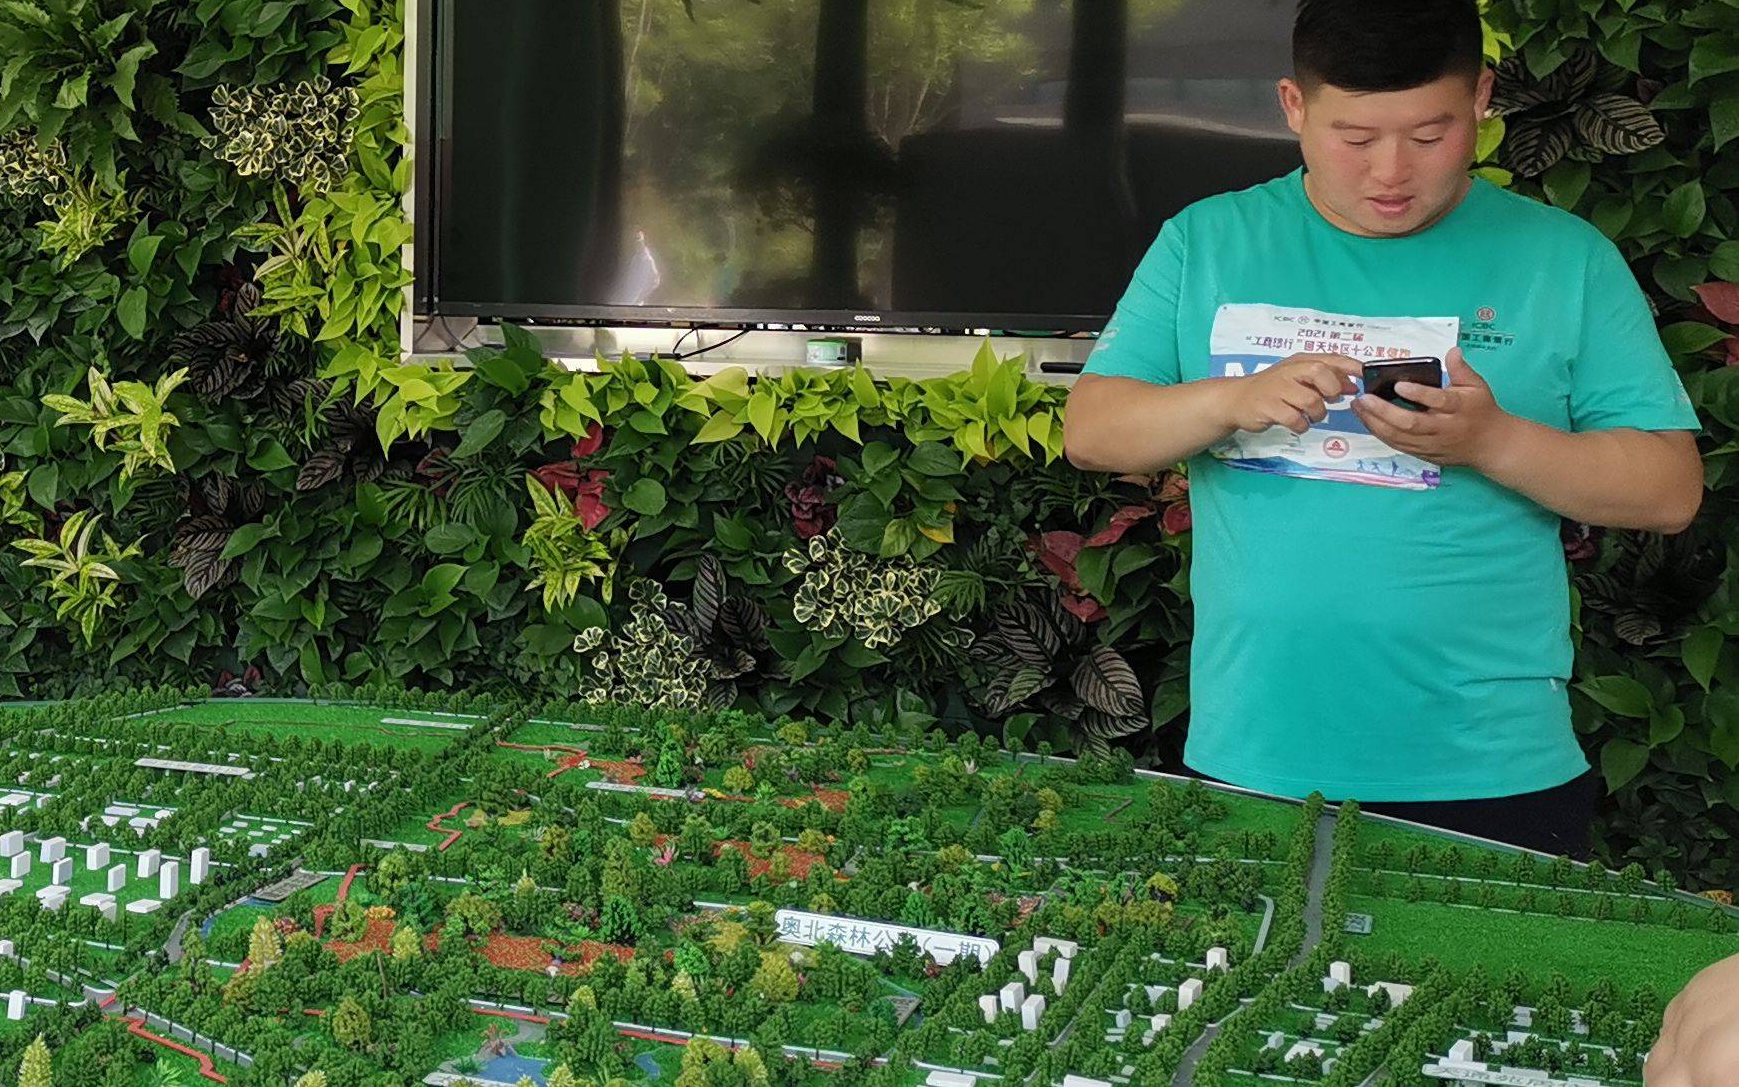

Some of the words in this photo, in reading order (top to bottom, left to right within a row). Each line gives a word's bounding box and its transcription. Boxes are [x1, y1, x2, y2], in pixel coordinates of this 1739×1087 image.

[1296, 328, 1326, 338] 2021
[1461, 332, 1514, 346] 国工商银行
